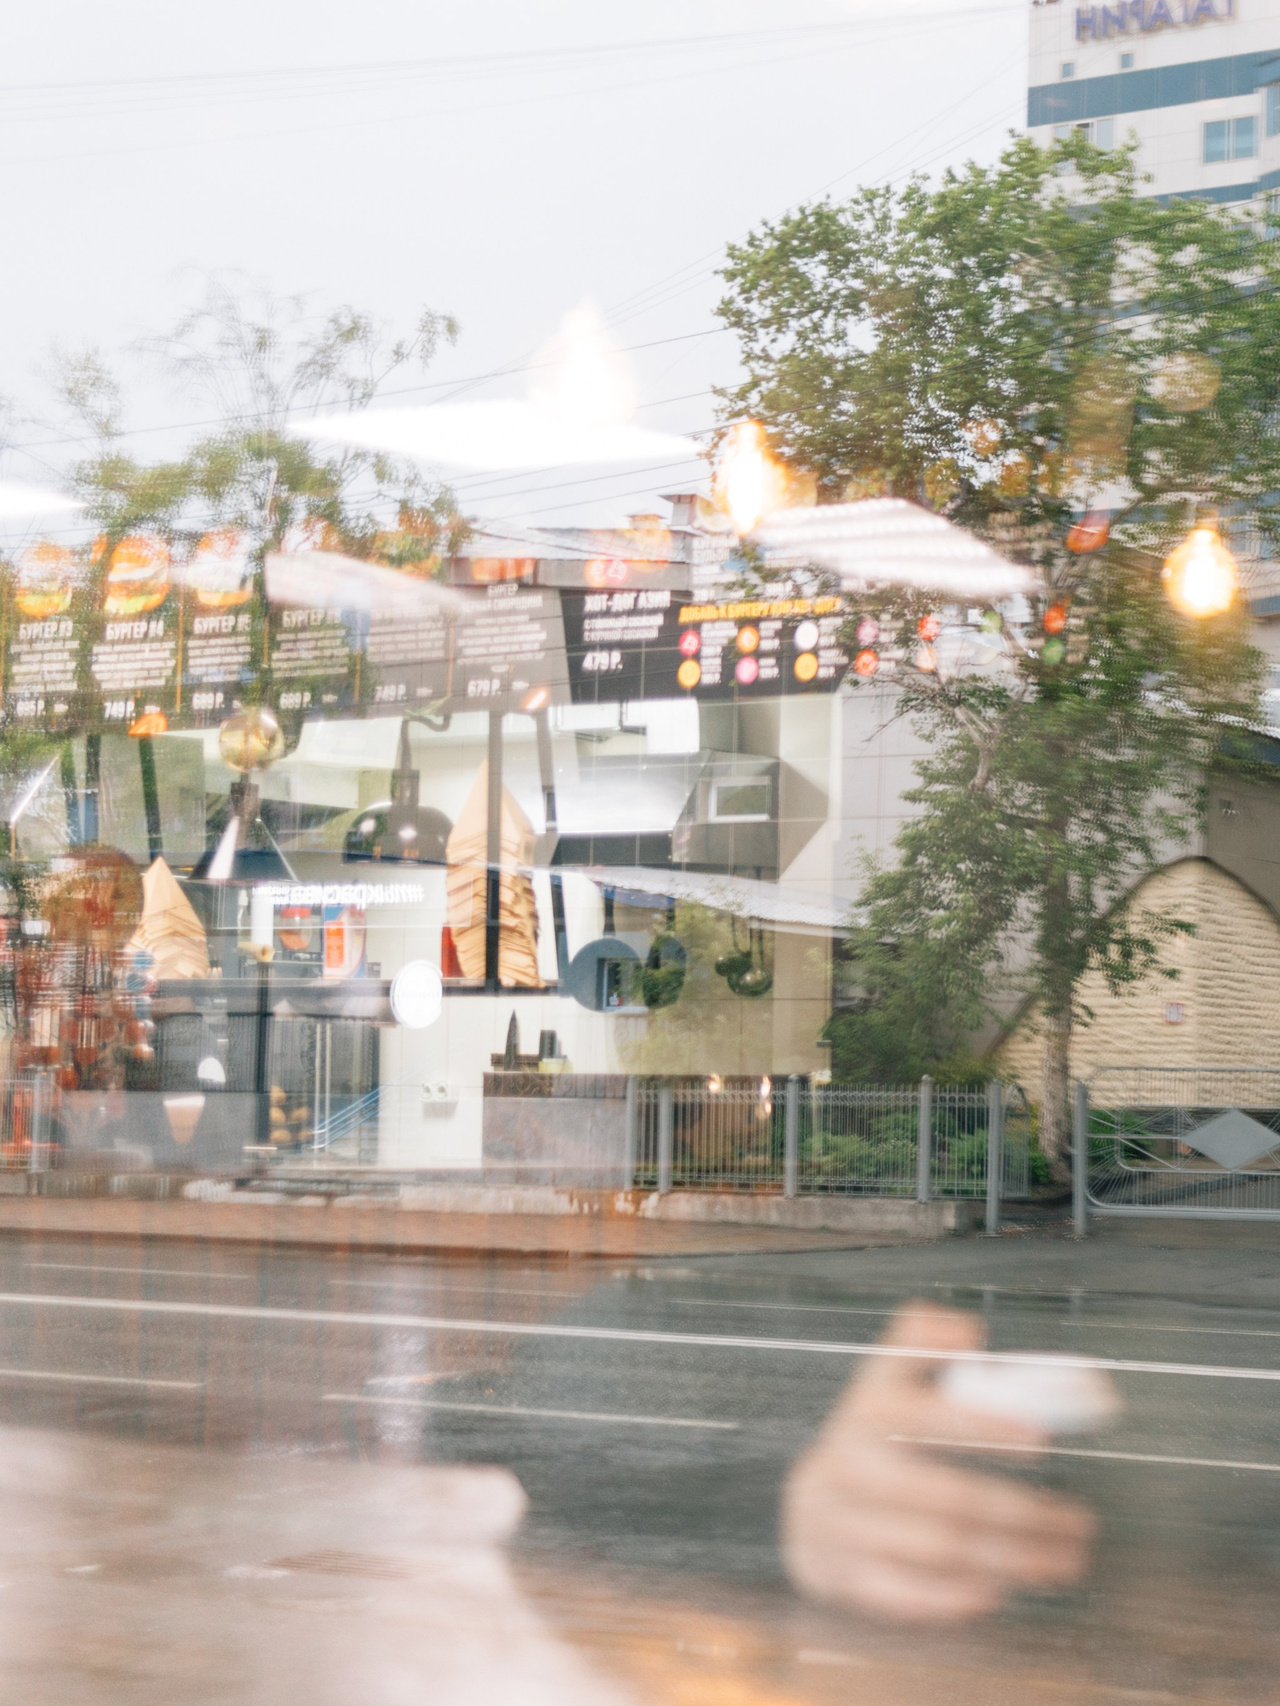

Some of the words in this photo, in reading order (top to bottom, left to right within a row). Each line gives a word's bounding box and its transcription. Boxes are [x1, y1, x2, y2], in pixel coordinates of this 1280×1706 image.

[488, 583, 518, 597] БУРГЕР
[583, 592, 638, 612] ХОТ-ДОГ
[193, 615, 236, 634] БУРГЕР
[283, 608, 324, 628] БУРГЕР
[19, 622, 58, 640] БУРГЕР
[106, 622, 147, 640] БУРГЕР
[582, 651, 610, 670] 479
[104, 701, 126, 718] 749
